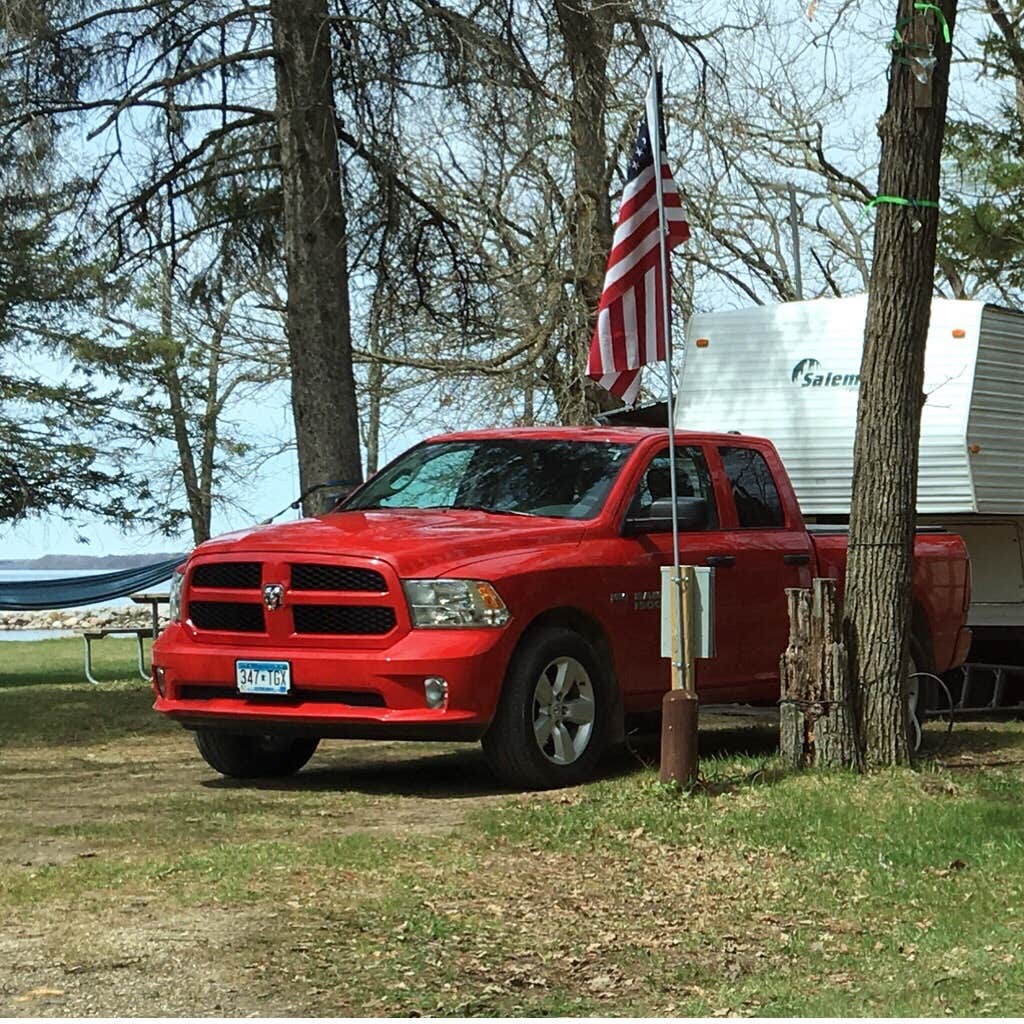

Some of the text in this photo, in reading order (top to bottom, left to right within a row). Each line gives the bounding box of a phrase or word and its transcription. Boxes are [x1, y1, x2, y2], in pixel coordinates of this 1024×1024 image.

[801, 372, 861, 387] Salem
[240, 669, 286, 686] 347 TGX
